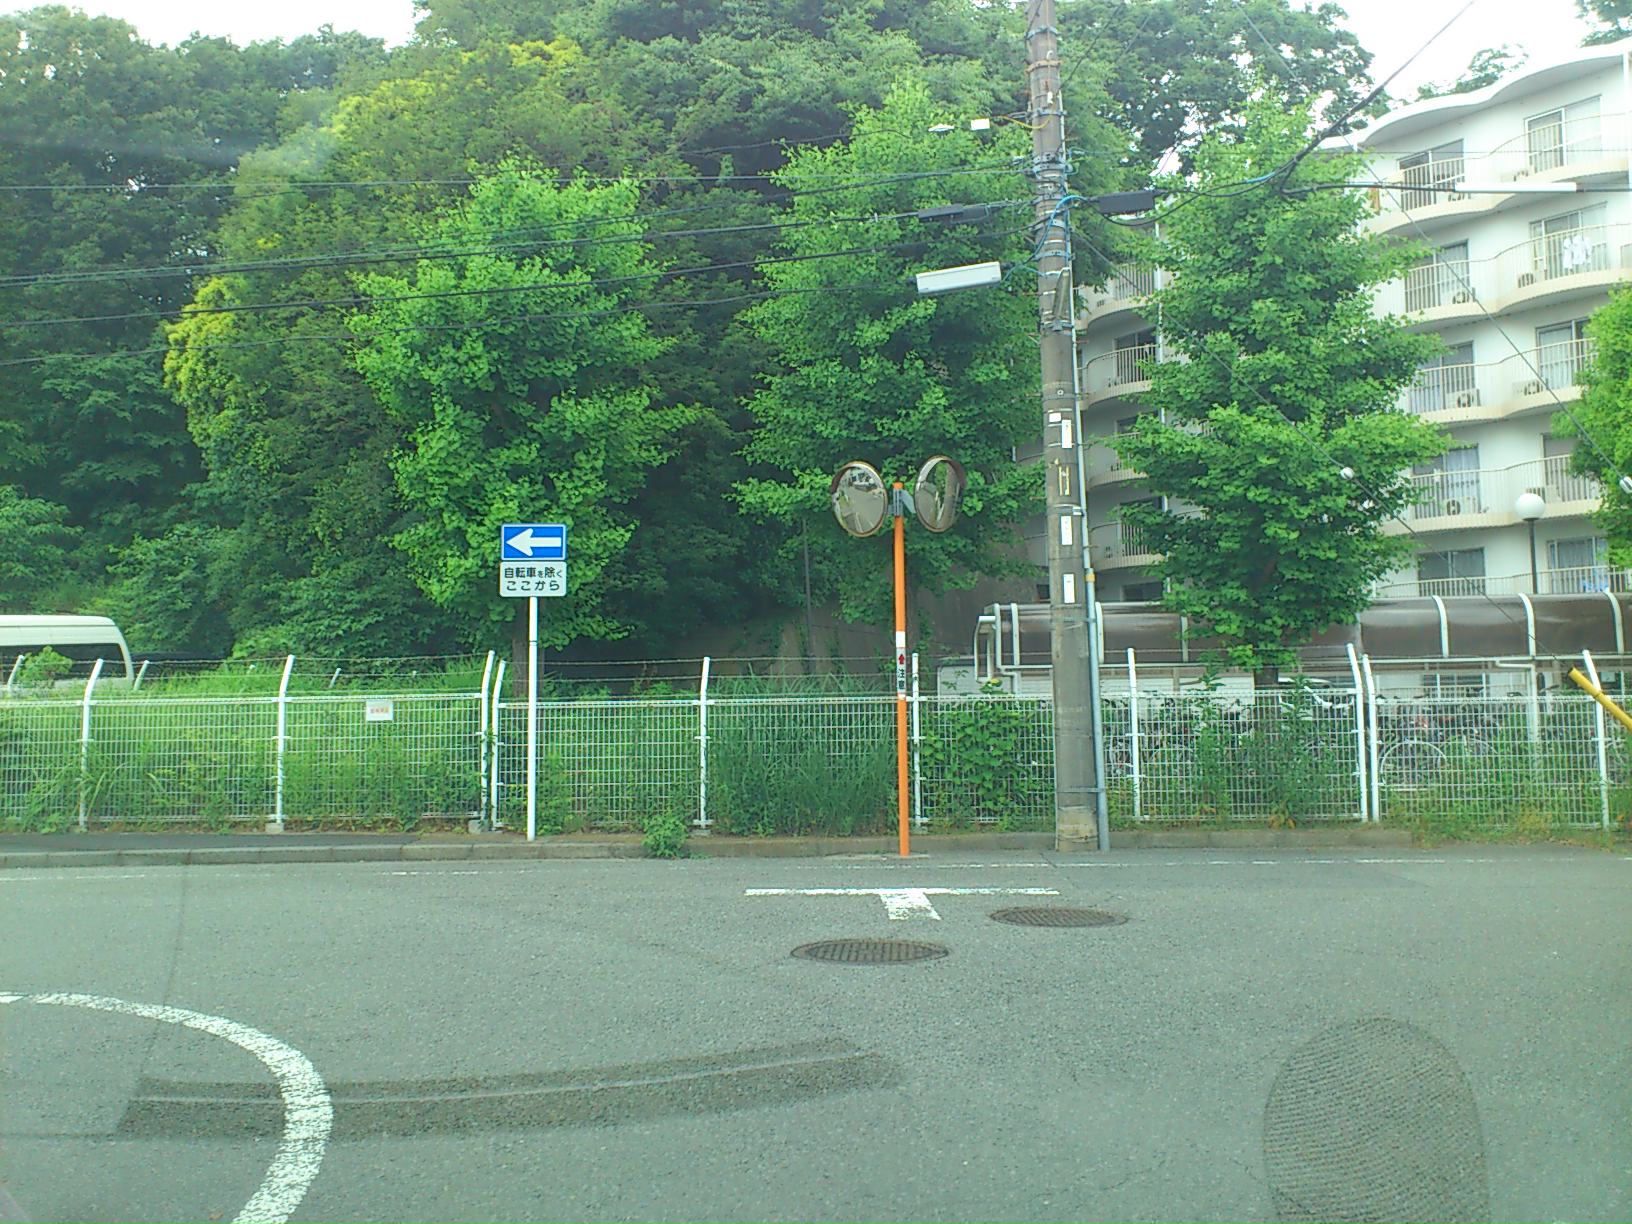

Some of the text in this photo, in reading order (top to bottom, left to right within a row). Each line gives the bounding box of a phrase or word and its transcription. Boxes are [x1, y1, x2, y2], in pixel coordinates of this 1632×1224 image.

[504, 566, 562, 578] 自転車を除く
[506, 580, 560, 591] ここから
[897, 668, 905, 689] 注意
